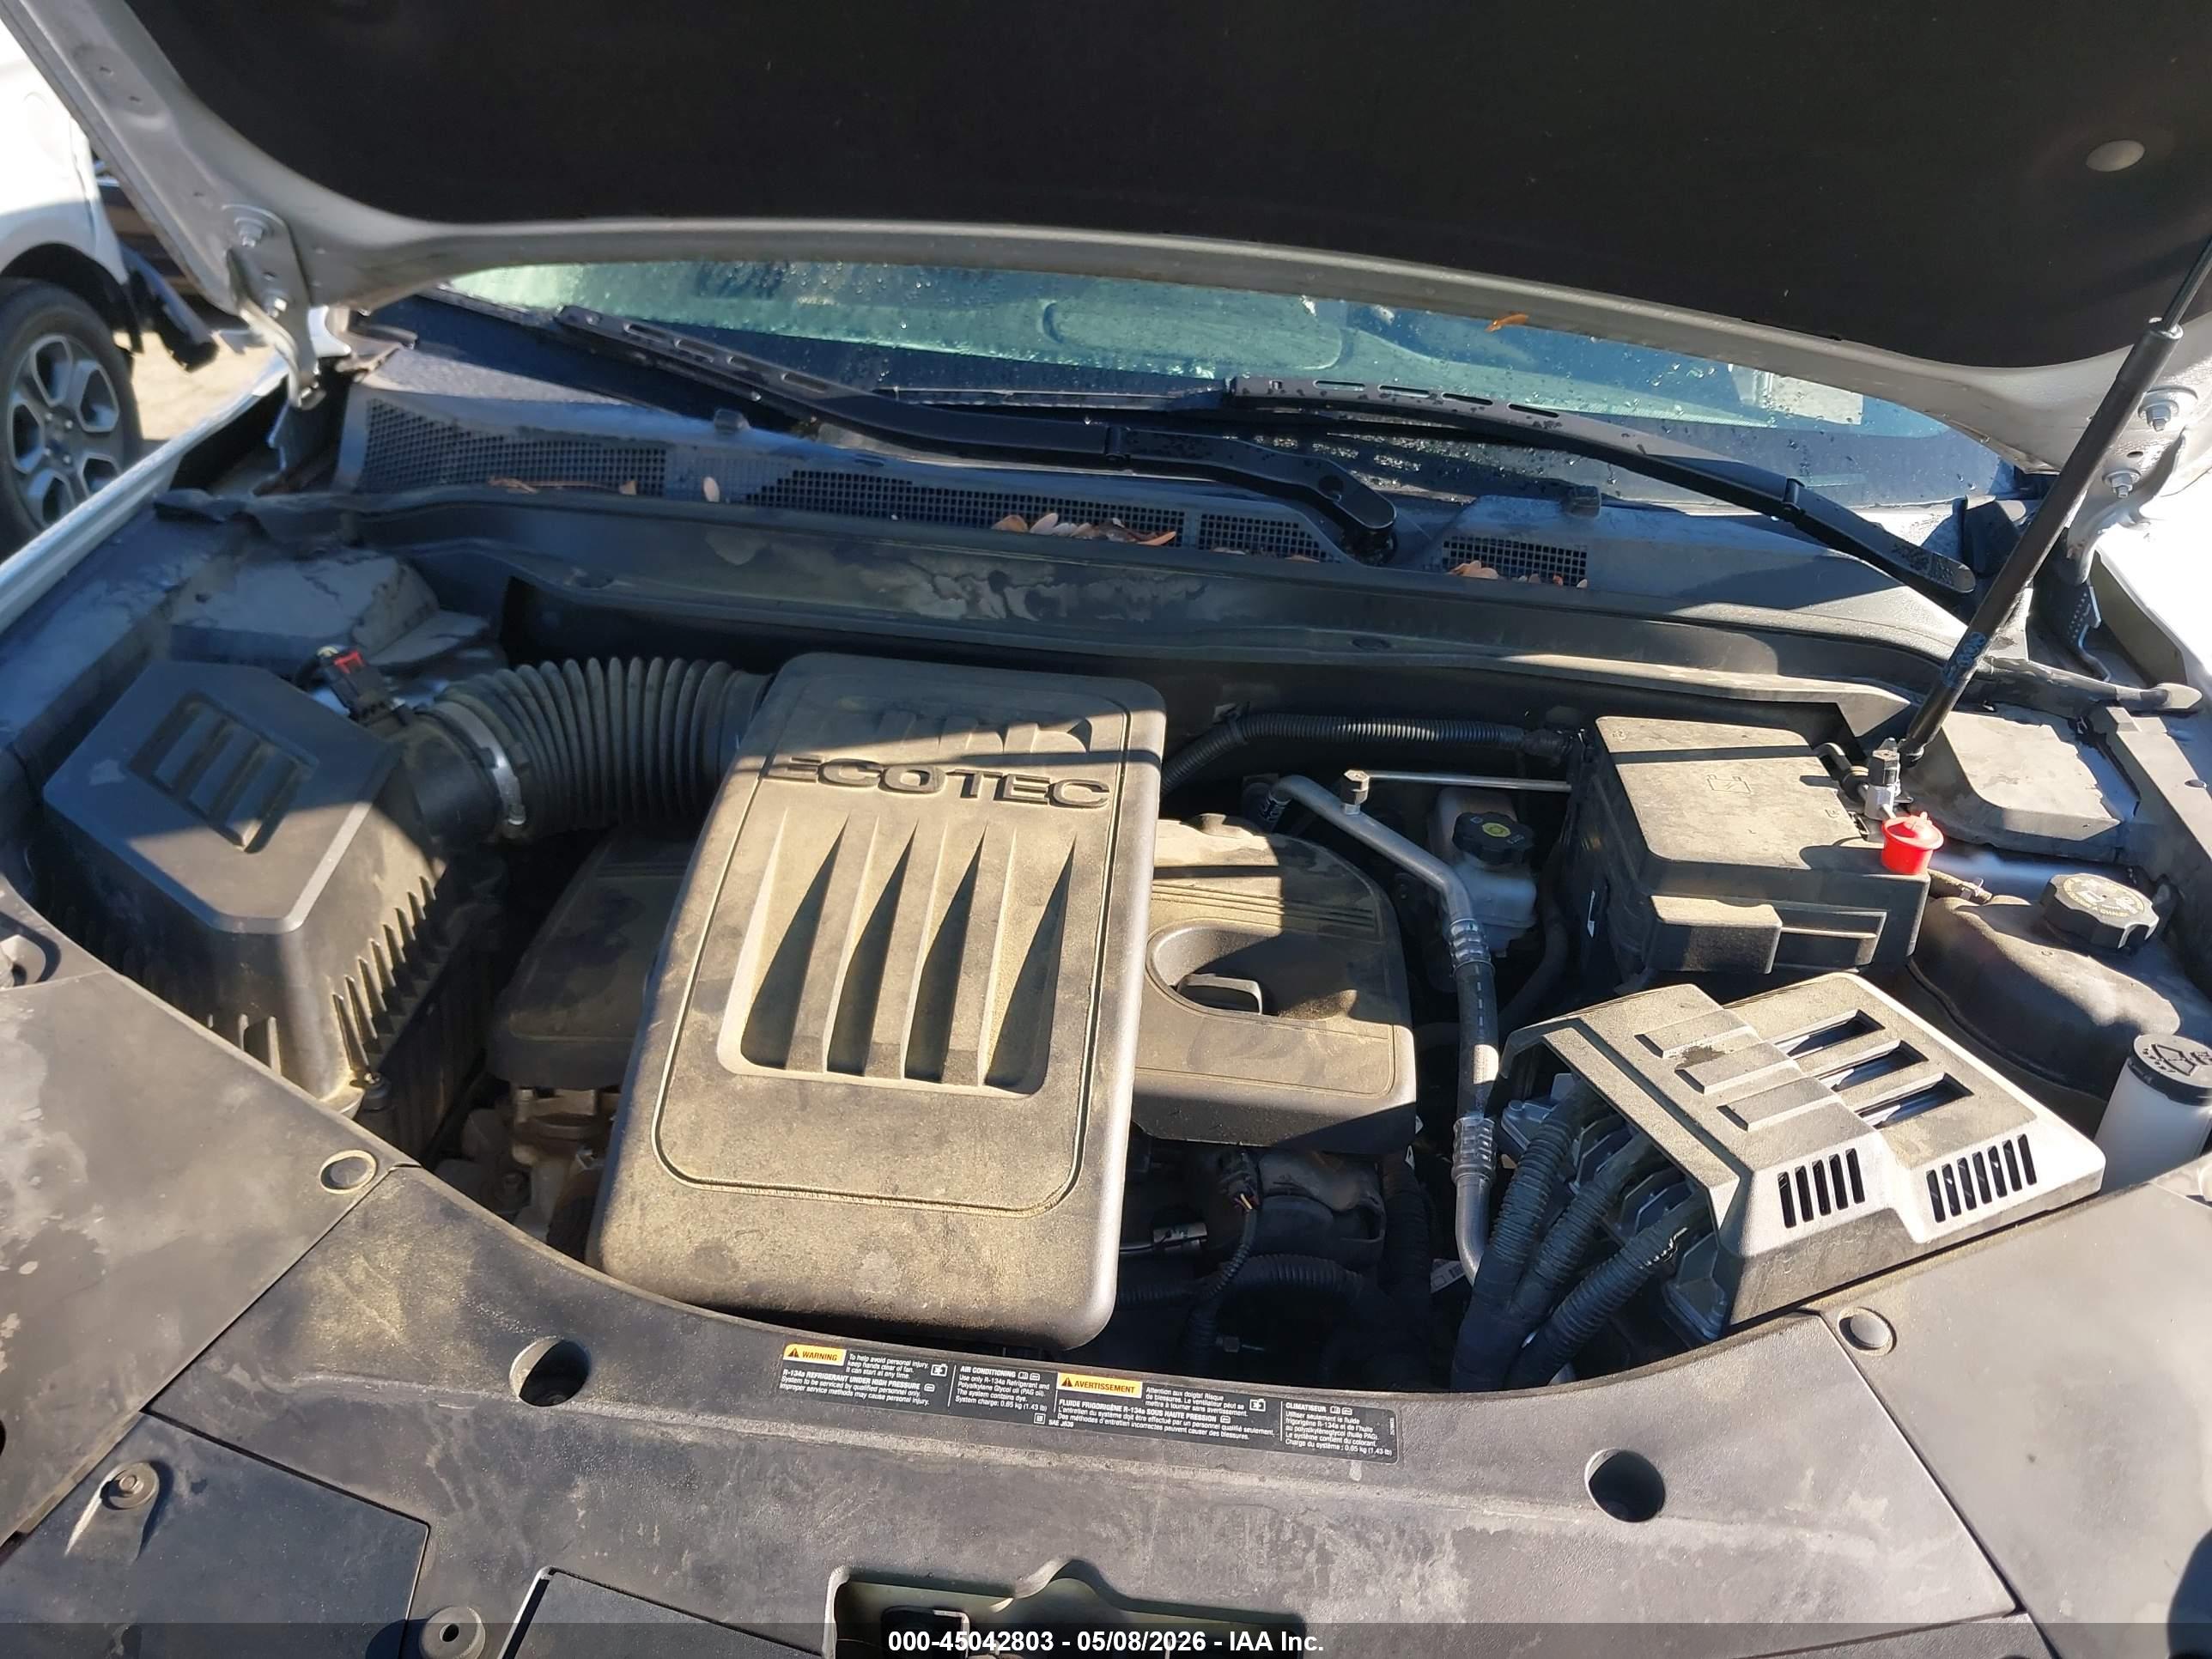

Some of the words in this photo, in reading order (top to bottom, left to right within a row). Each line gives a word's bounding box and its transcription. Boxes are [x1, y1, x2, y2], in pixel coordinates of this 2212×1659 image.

[770, 754, 1110, 809] ECOTEC
[803, 1351, 837, 1361] WARNING
[912, 1360, 928, 1369] injury.
[972, 1367, 1016, 1377] CONDITIONING
[781, 1376, 803, 1384] System
[806, 1371, 849, 1382] REFRIGERANT
[888, 1381, 921, 1389] PRESSURE
[1006, 1379, 1037, 1388] Refrigerant
[957, 1382, 993, 1390] Polyalkylene
[1074, 1381, 1135, 1393] AVERTISSEMENT
[780, 1383, 805, 1392] Improper
[854, 1391, 866, 1400] may
[1146, 1387, 1171, 1395] Attention
[1193, 1399, 1222, 1407] ventilateur
[1285, 1402, 1327, 1413] CLIMATISEUR
[1123, 1406, 1146, 1414] R-134a
[1164, 1409, 1184, 1419] HAUTE
[1186, 1413, 1217, 1423] PRESSION
[1306, 1413, 1336, 1422] seulement
[1132, 1421, 1163, 1430] incorrectes
[1192, 1421, 1220, 1430] personnel
[1285, 1438, 1305, 1447] Charge
